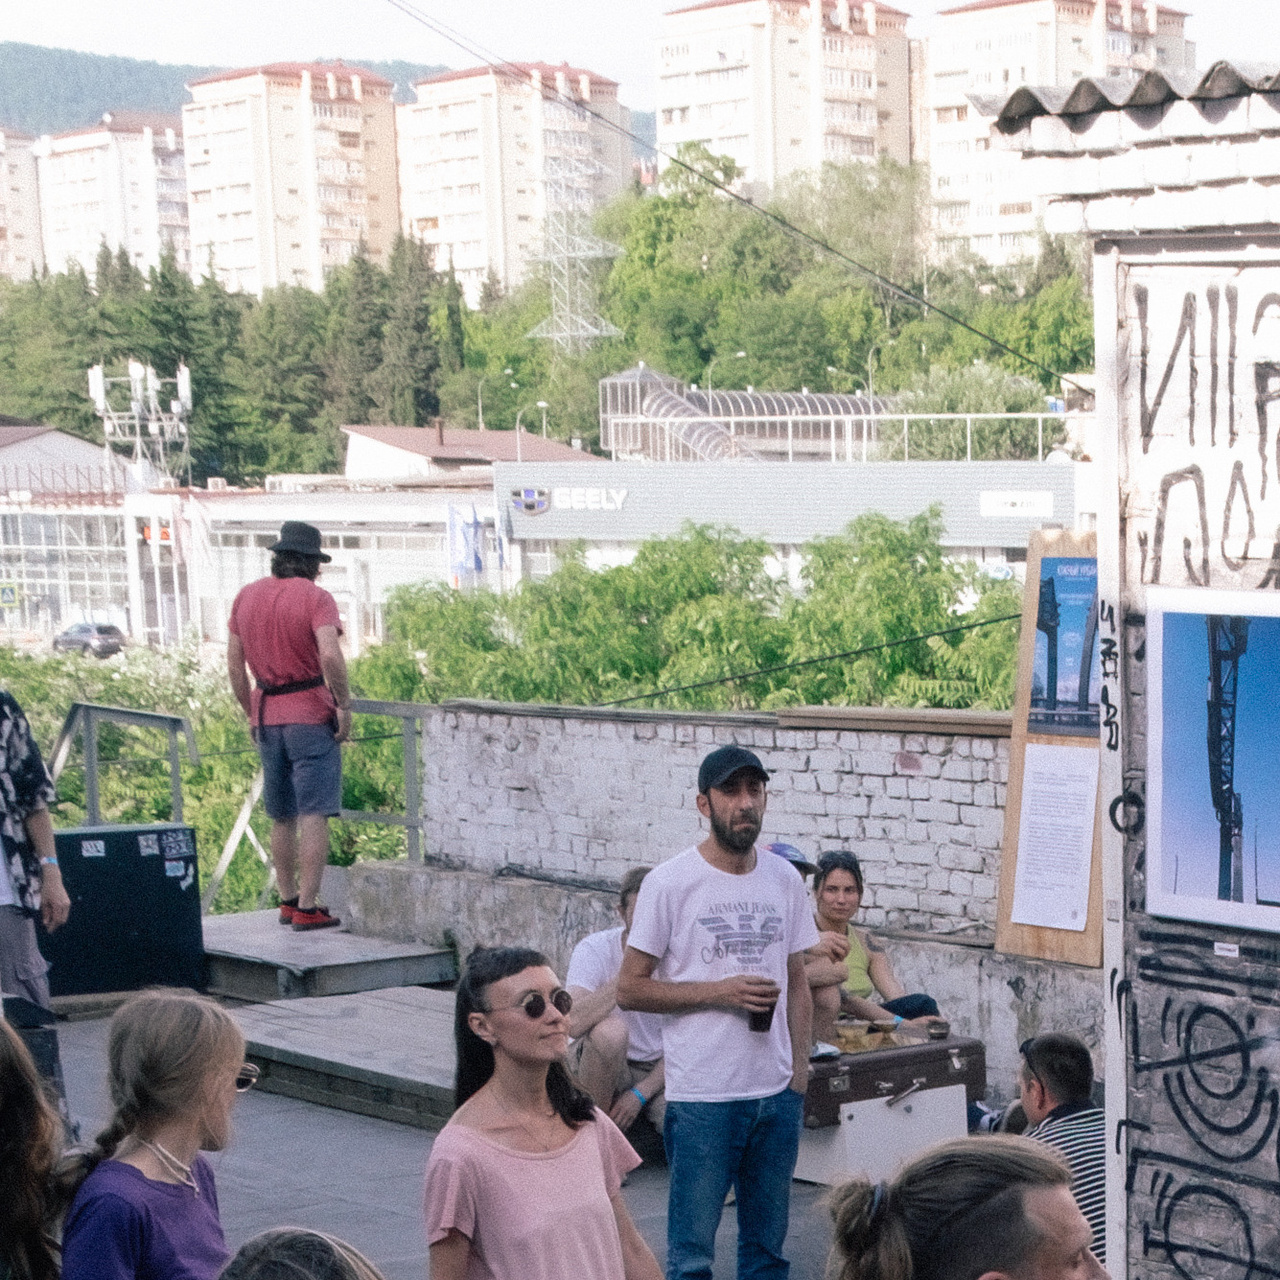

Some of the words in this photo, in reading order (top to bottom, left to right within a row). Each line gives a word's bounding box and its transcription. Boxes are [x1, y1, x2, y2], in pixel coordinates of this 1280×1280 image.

[553, 487, 628, 509] GEELY
[708, 902, 748, 915] ARMANI
[751, 902, 777, 914] JEANS
